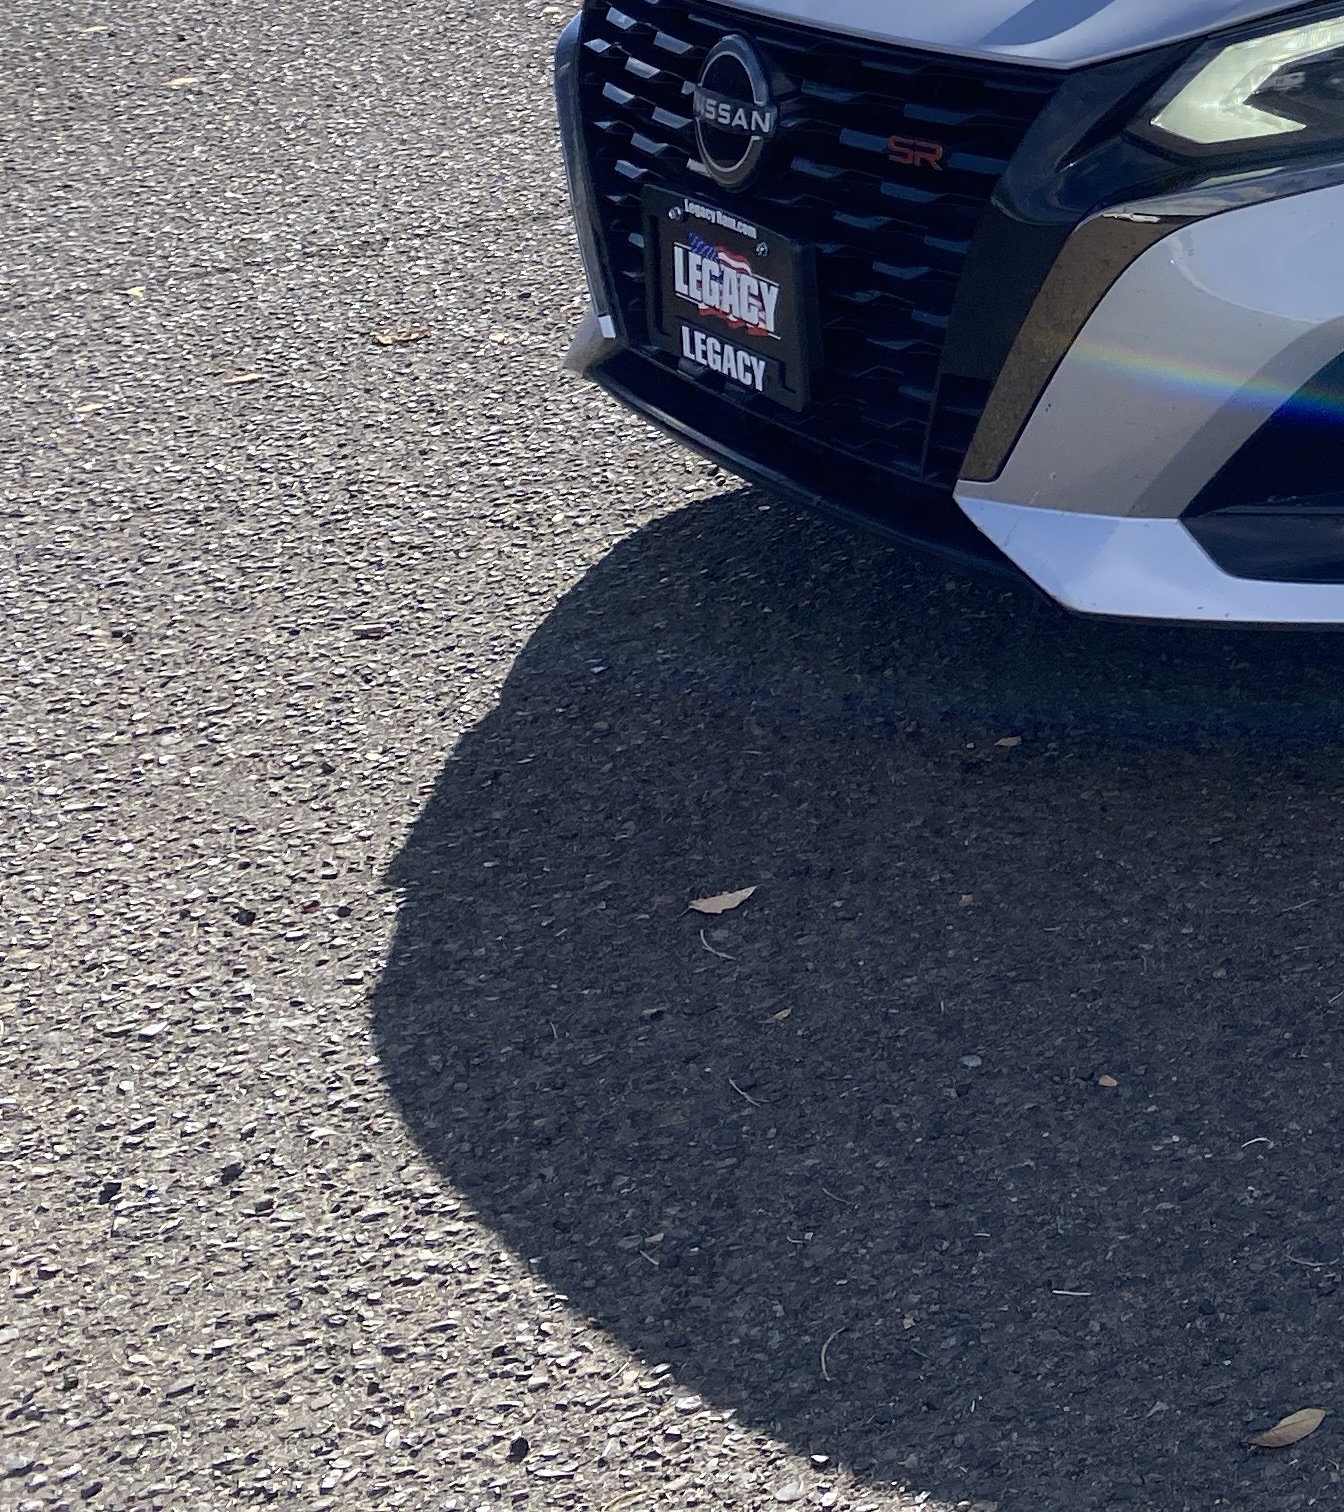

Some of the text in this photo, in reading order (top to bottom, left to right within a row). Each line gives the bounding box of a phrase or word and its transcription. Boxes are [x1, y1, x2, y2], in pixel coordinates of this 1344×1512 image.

[888, 135, 943, 172] SR
[673, 244, 780, 333] LEGACY
[681, 324, 766, 392] LEGACY
